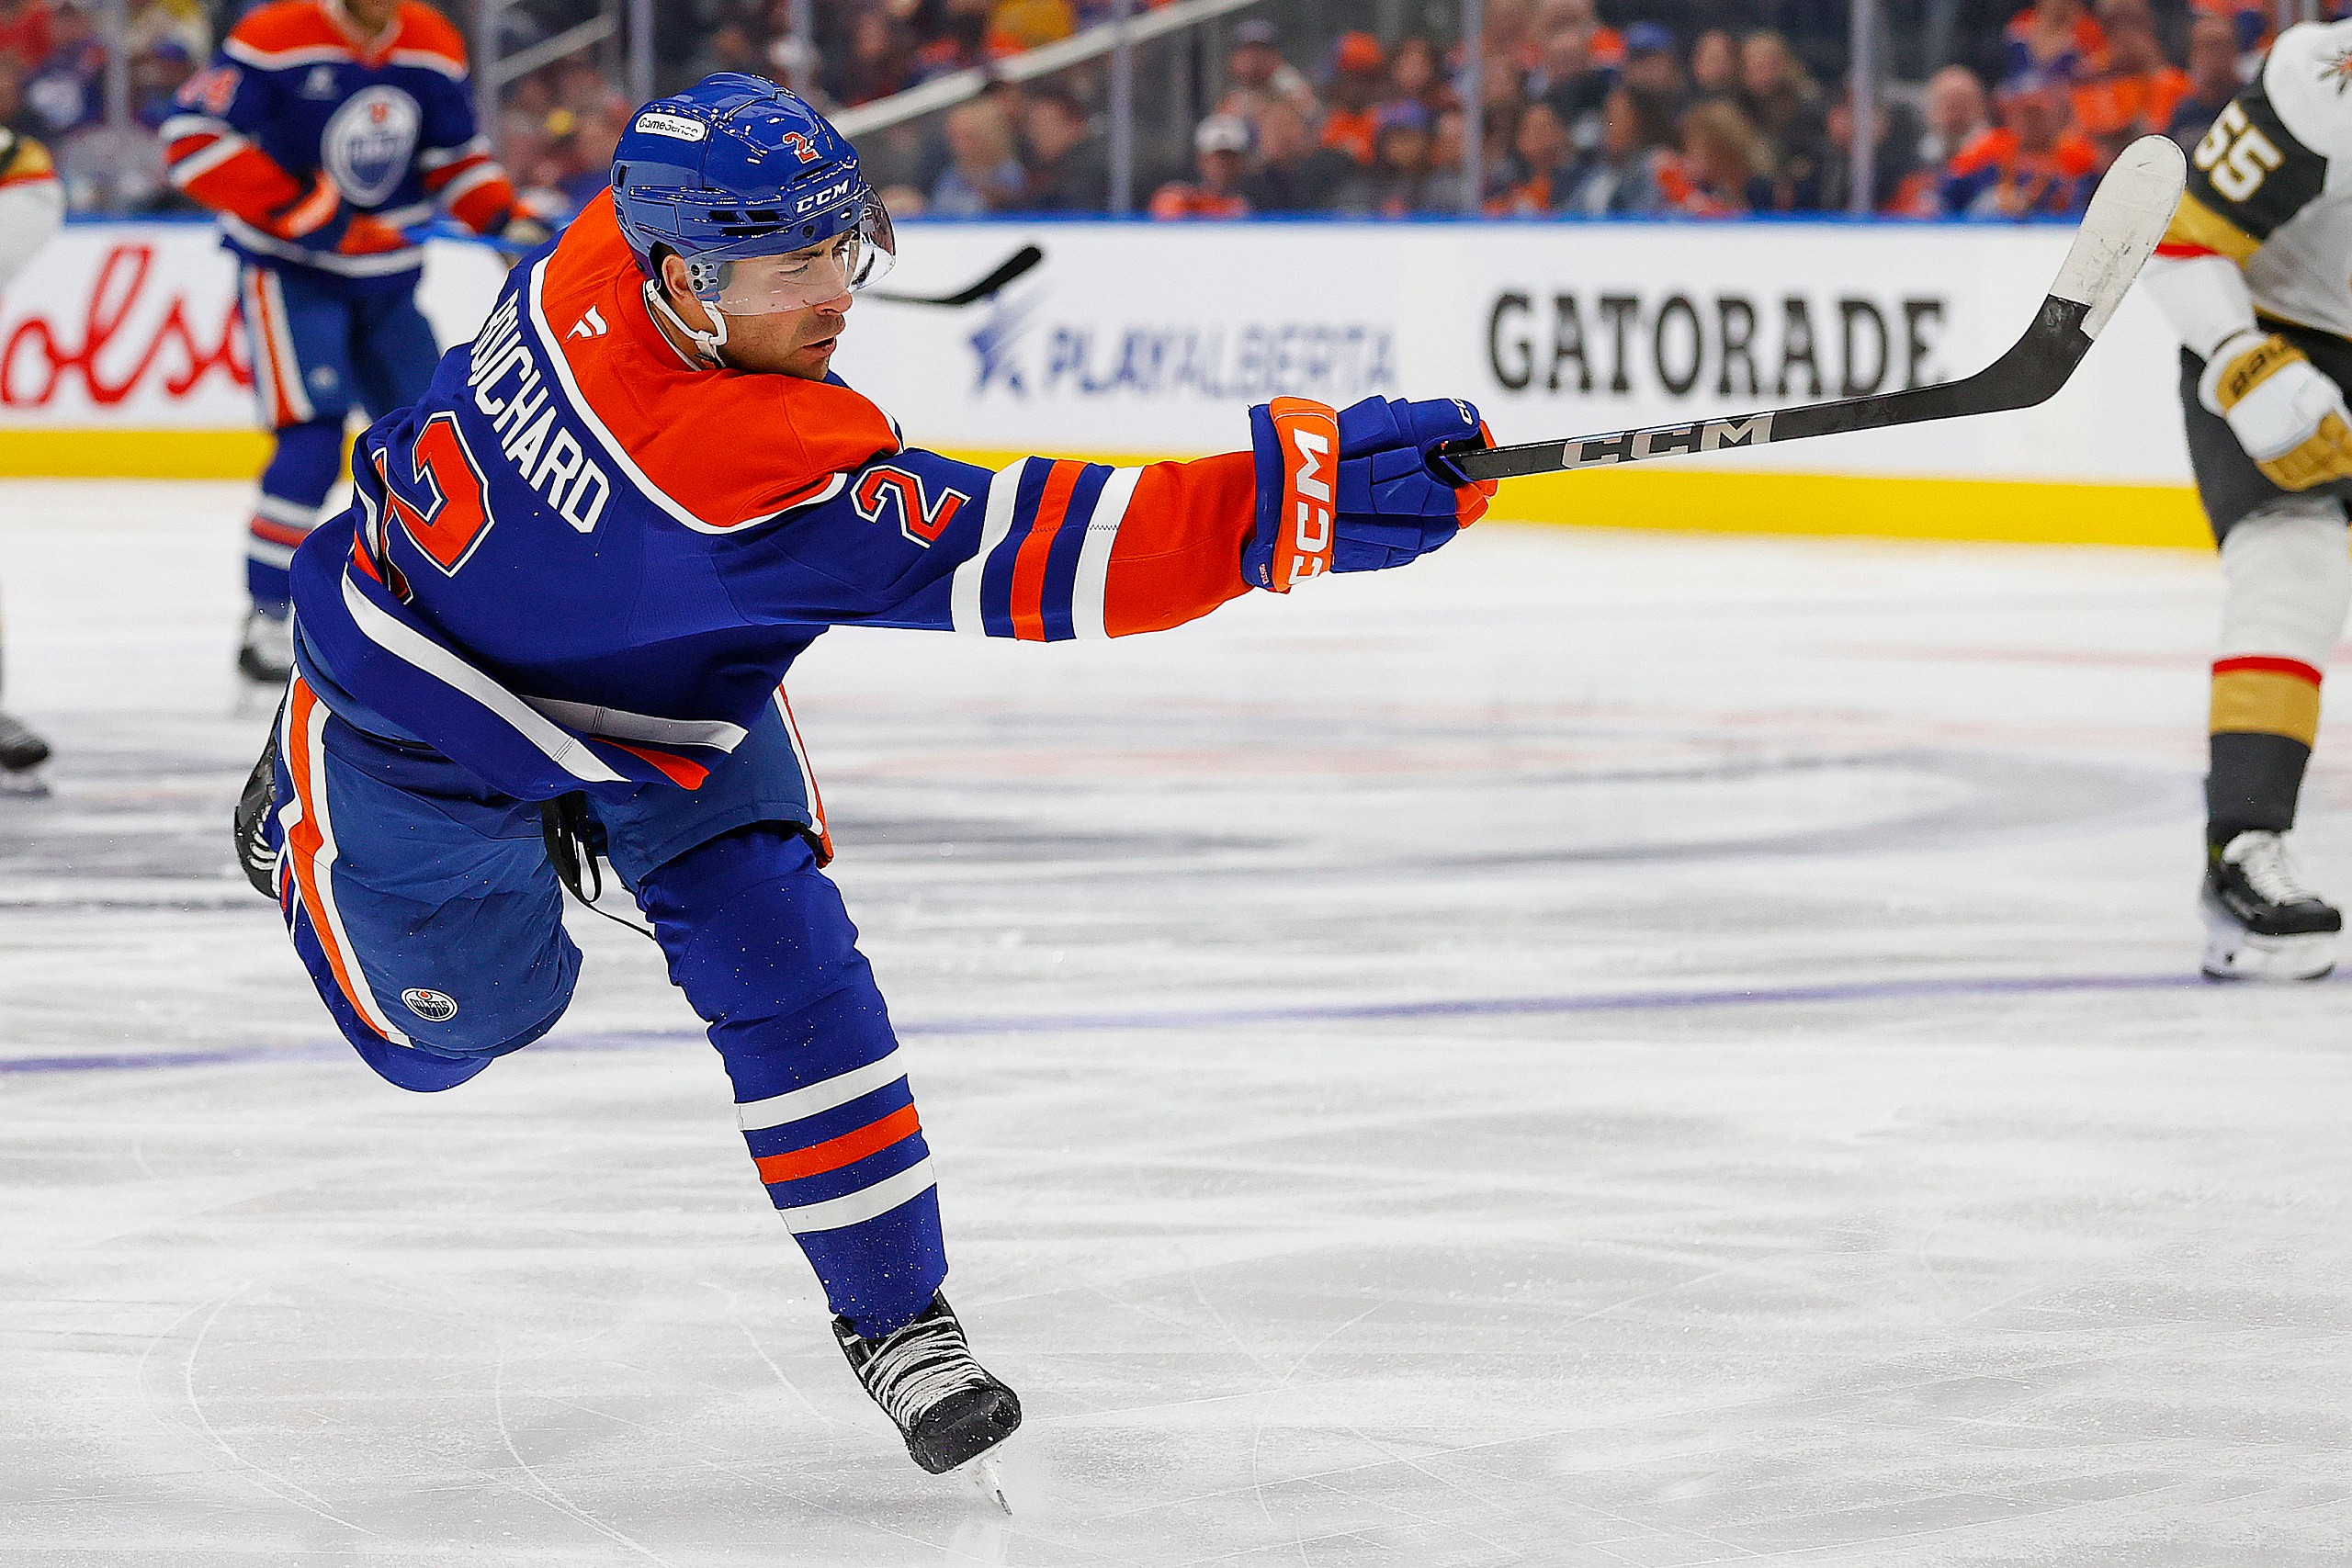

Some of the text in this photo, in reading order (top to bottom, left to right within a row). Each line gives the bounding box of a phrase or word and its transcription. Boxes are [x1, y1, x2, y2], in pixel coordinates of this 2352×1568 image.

[639, 117, 698, 138] GameSense
[782, 132, 820, 164] 2
[2193, 97, 2286, 203] 55
[796, 179, 849, 214] CCM
[1486, 289, 1946, 398] GATORADE
[467, 288, 611, 534] BOUCHARD
[1562, 412, 1776, 469] CCM
[370, 410, 497, 607] 2
[849, 464, 982, 549] 2
[1288, 427, 1331, 585] CCM
